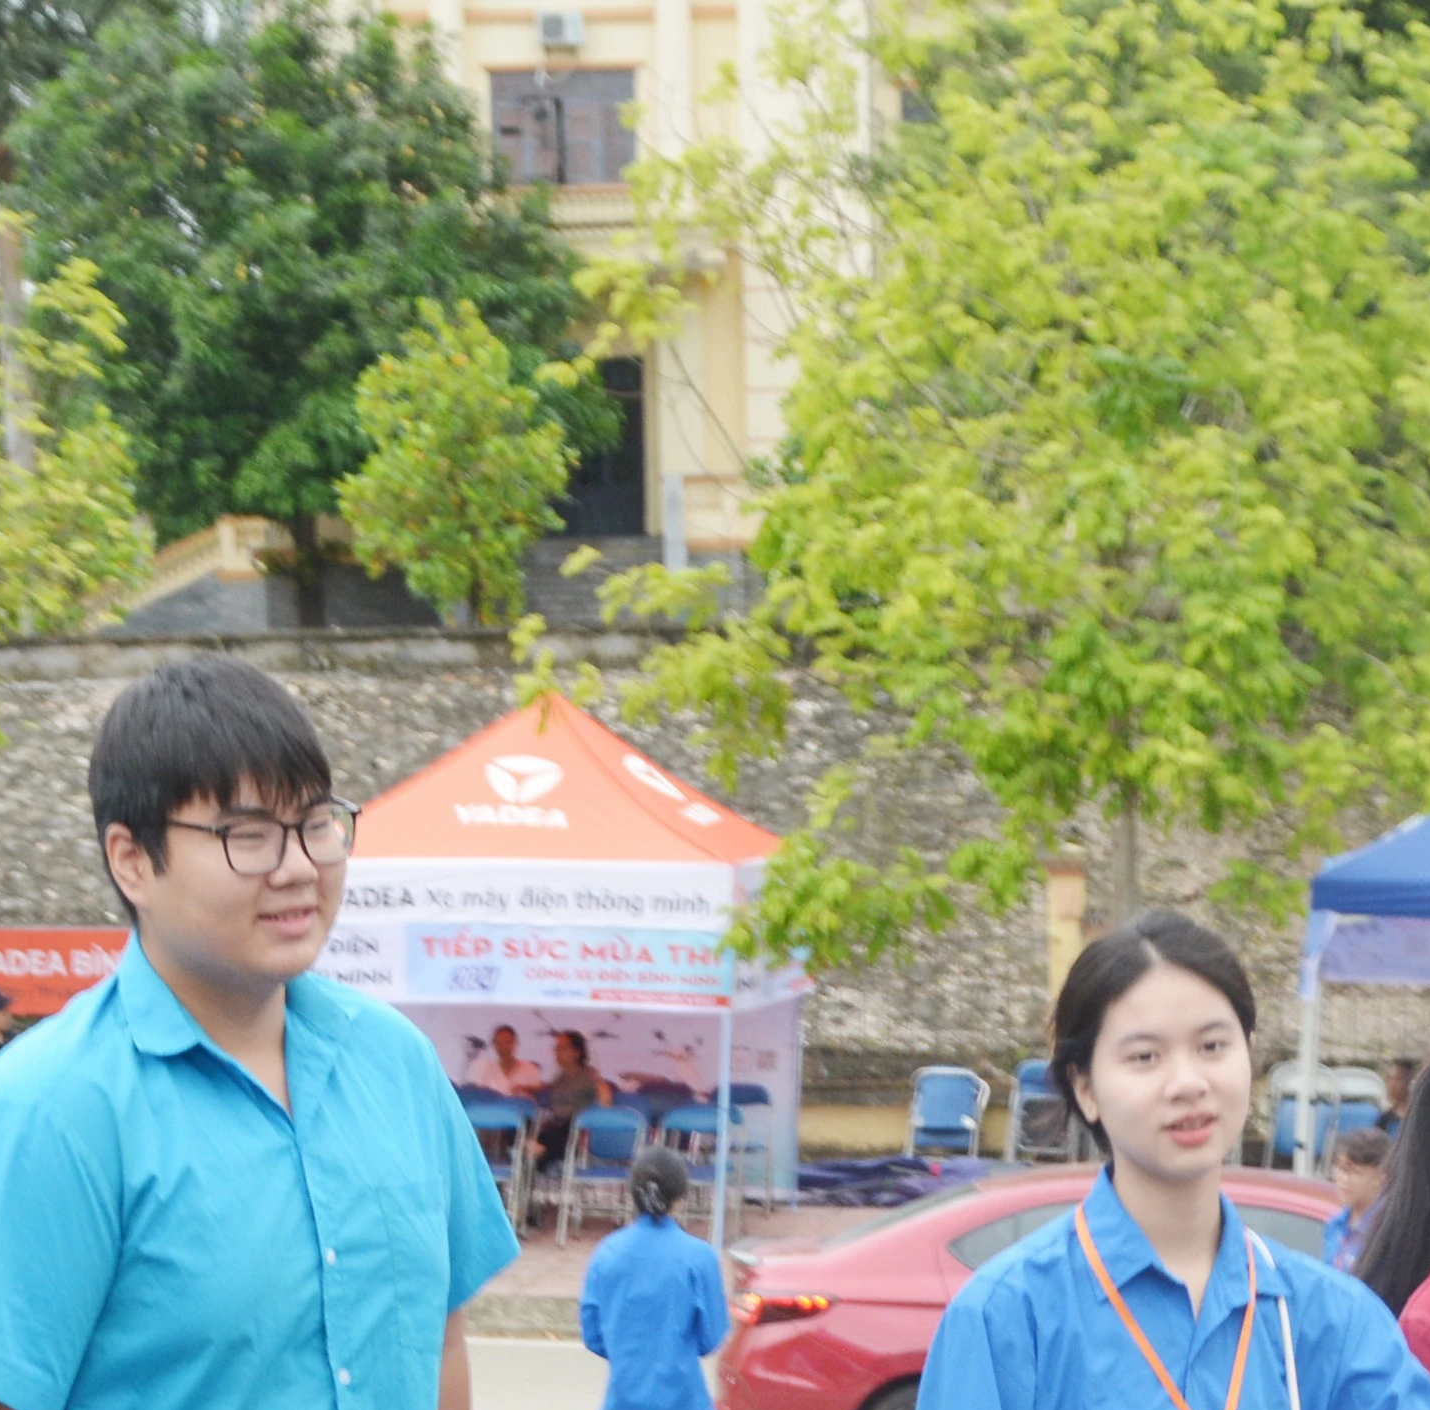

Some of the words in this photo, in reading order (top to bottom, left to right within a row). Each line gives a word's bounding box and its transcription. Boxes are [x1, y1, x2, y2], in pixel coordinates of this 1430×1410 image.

[341, 887, 416, 909] ADEA
[421, 926, 494, 959] TIẾP
[579, 935, 654, 965] MÙA
